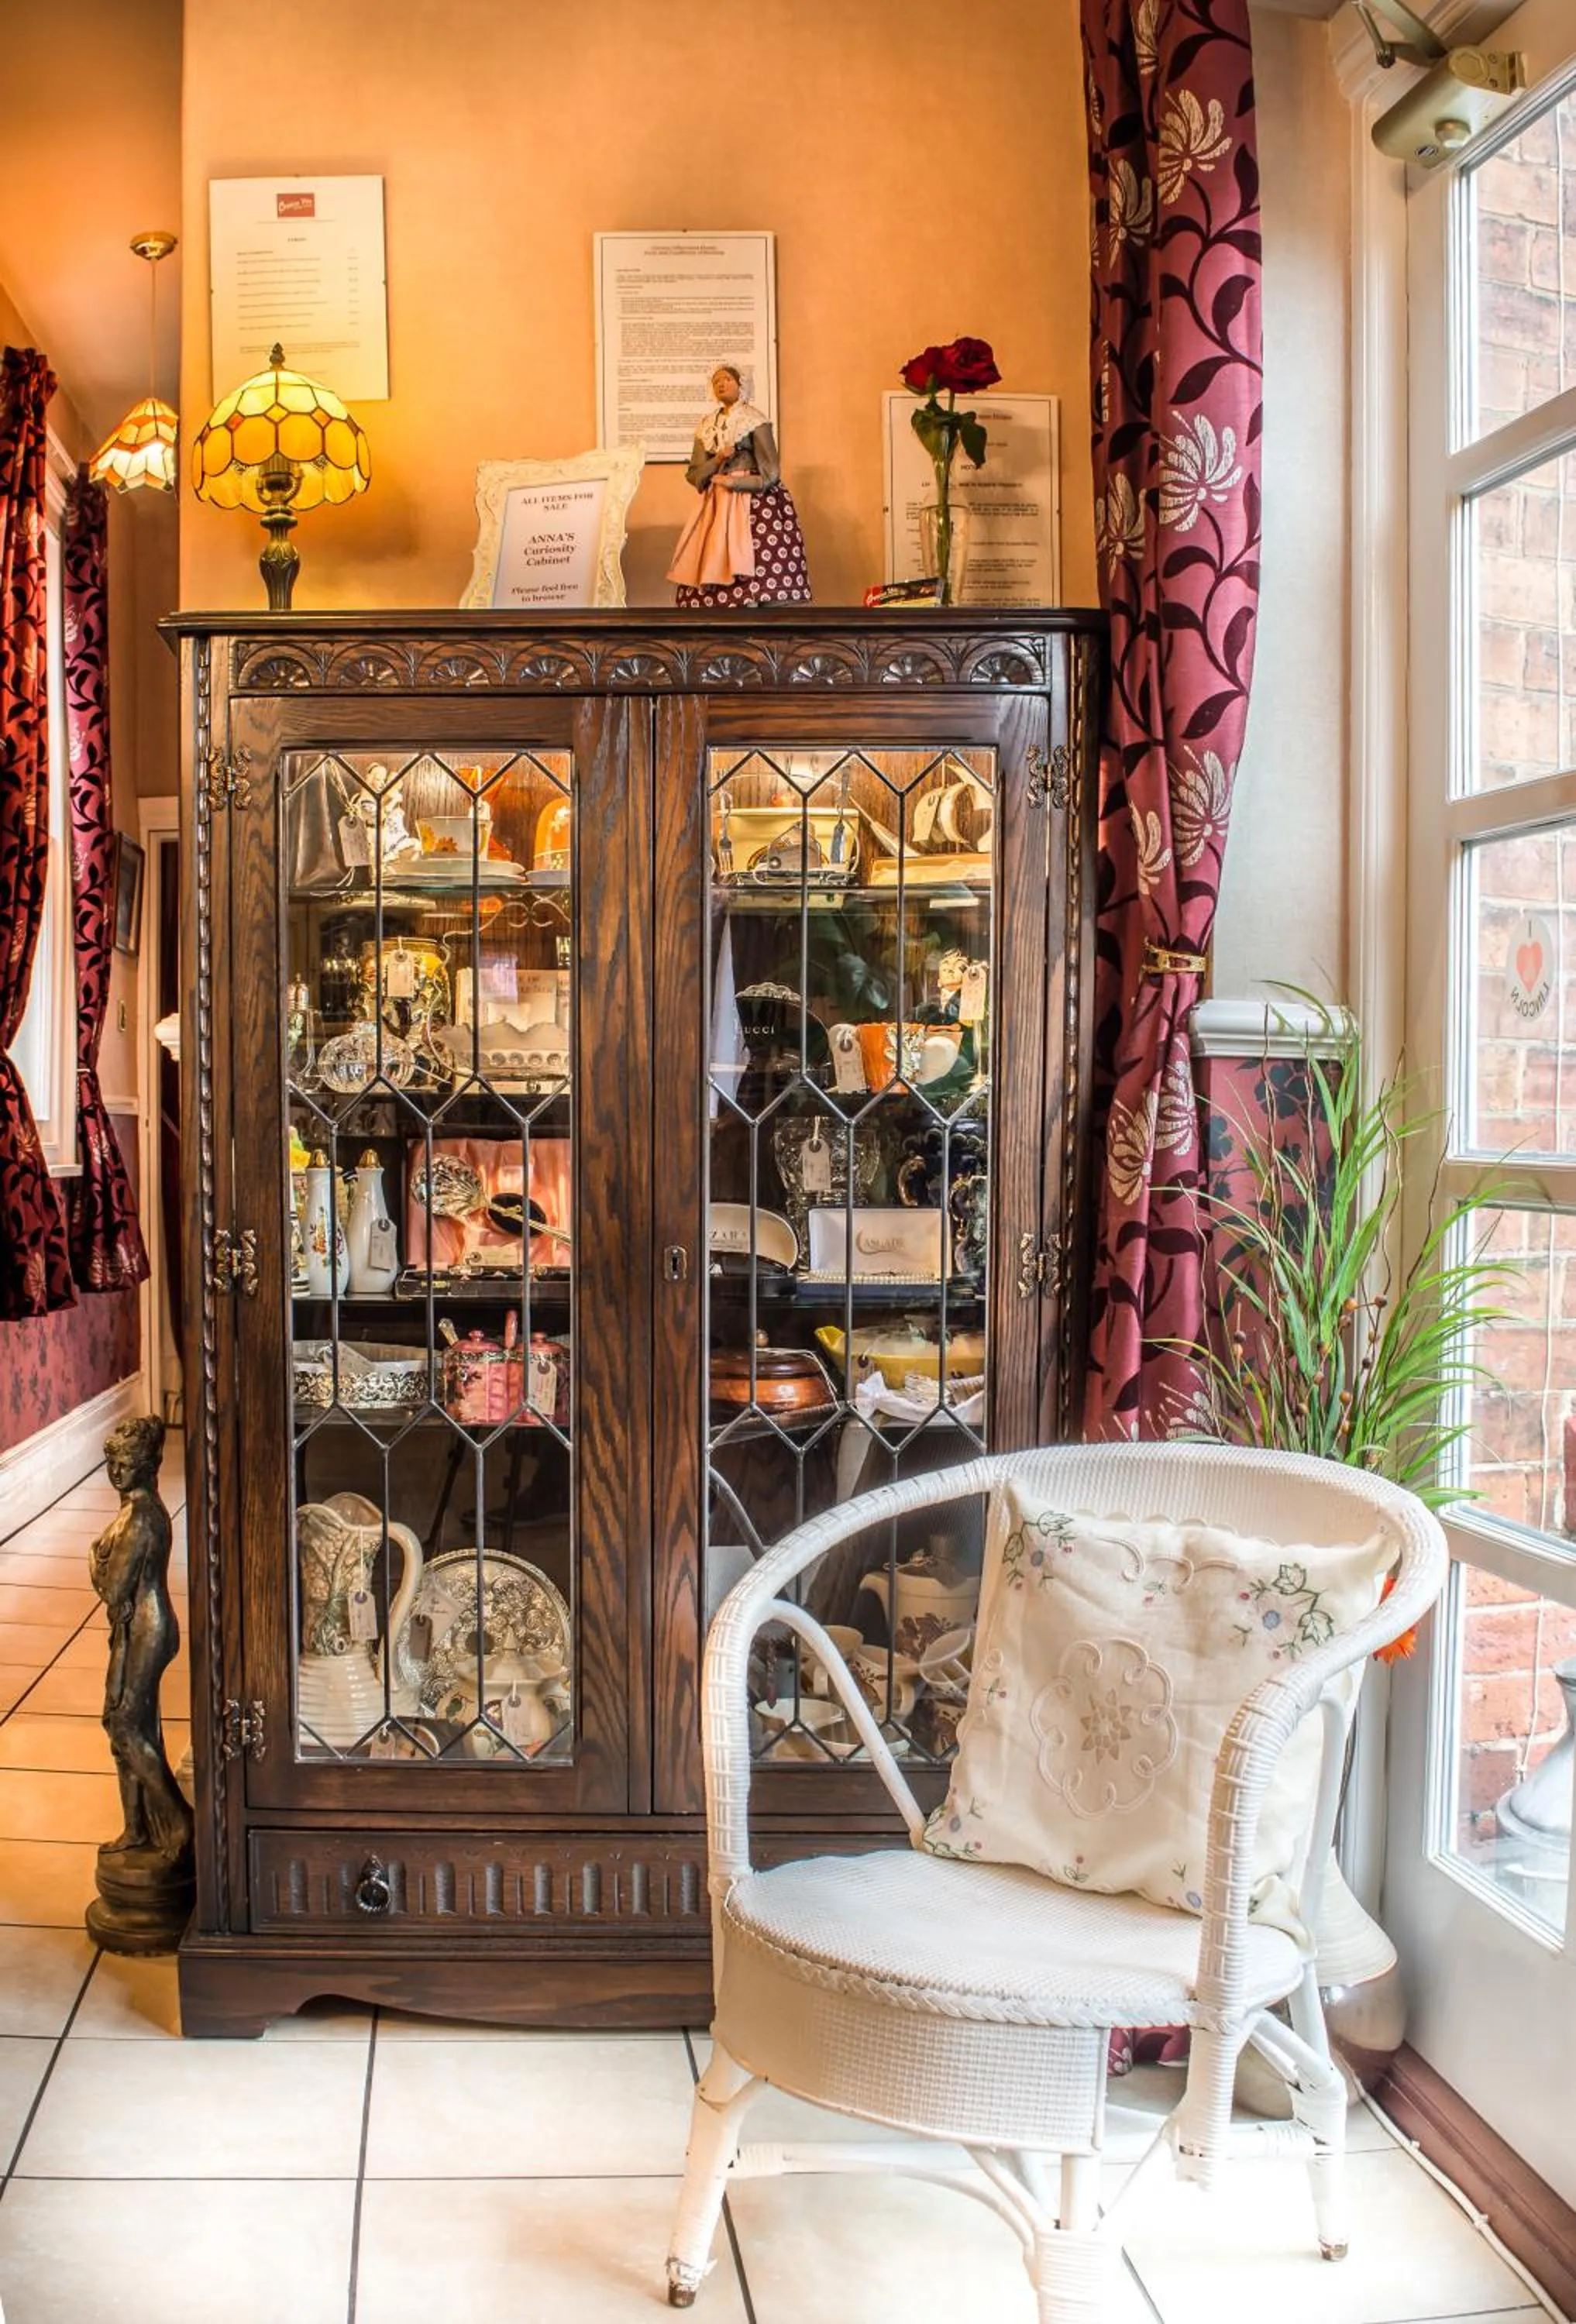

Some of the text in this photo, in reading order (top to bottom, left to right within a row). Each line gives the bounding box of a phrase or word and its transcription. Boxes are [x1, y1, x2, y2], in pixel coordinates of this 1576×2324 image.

[541, 494, 573, 504] ITEMS
[529, 532, 575, 544] ANNA'S
[523, 544, 577, 556] Curiosity
[525, 555, 571, 567] Cabinet
[511, 582, 579, 595] Please feel free
[532, 593, 566, 603] browse
[742, 1025, 775, 1035] UCCI
